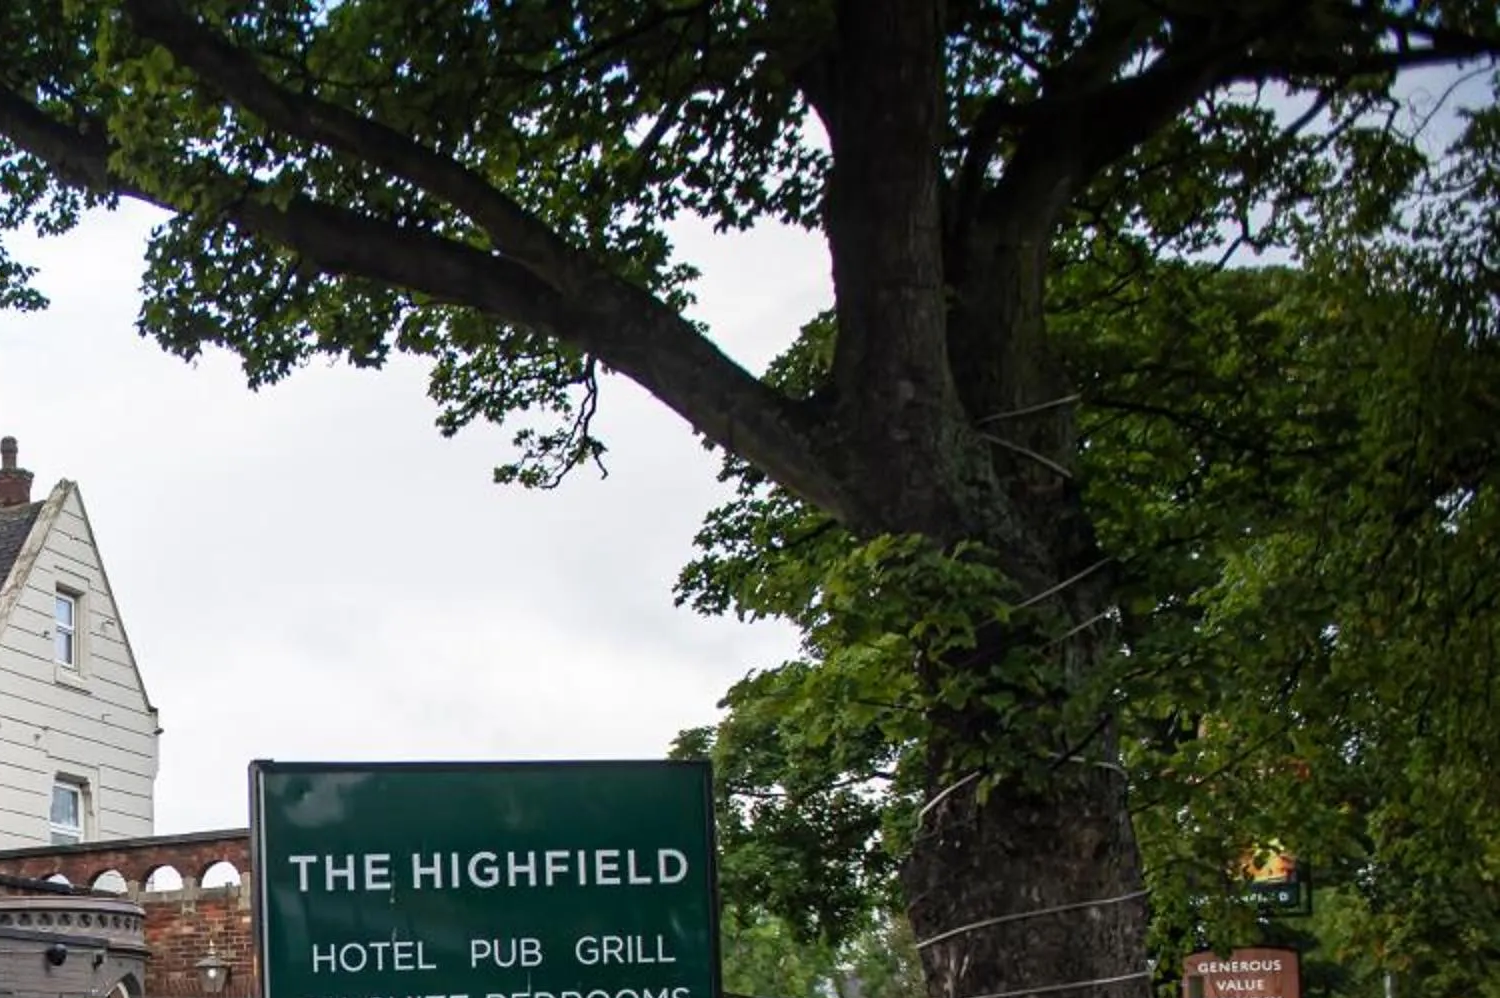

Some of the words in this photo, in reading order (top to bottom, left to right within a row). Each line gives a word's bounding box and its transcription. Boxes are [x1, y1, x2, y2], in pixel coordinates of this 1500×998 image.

[289, 853, 392, 892] THE
[412, 848, 689, 890] HIGHFIELD
[312, 941, 437, 973] HOTEL
[470, 937, 543, 968] PUB
[574, 935, 676, 965] GRILL
[1197, 959, 1282, 973] GENEROUS
[1216, 979, 1265, 991] VALUE
